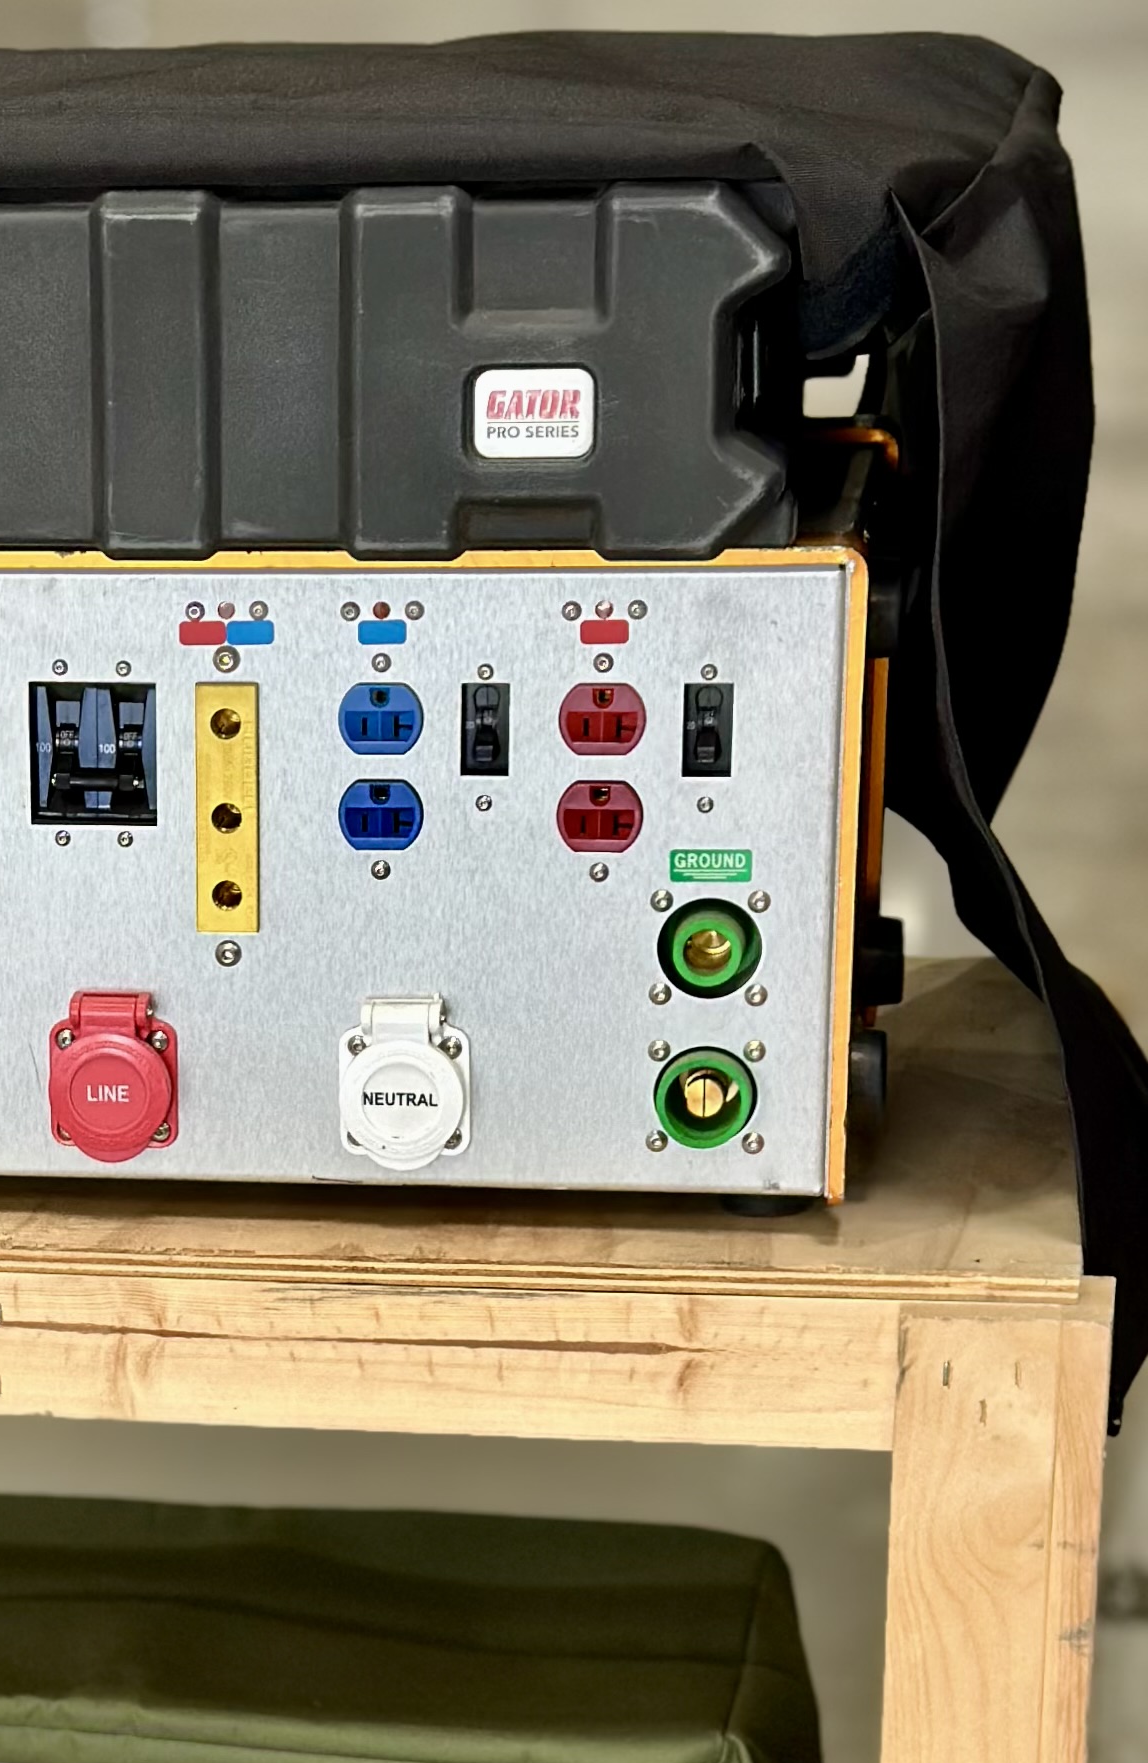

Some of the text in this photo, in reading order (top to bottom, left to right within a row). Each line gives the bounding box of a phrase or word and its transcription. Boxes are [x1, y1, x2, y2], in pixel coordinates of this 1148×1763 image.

[486, 389, 581, 420] GATOR
[486, 425, 579, 439] PRO SERIES
[98, 743, 116, 754] 100
[674, 853, 746, 868] GROUND
[86, 1085, 130, 1103] LINE
[362, 1092, 438, 1107] NEUTRAL
